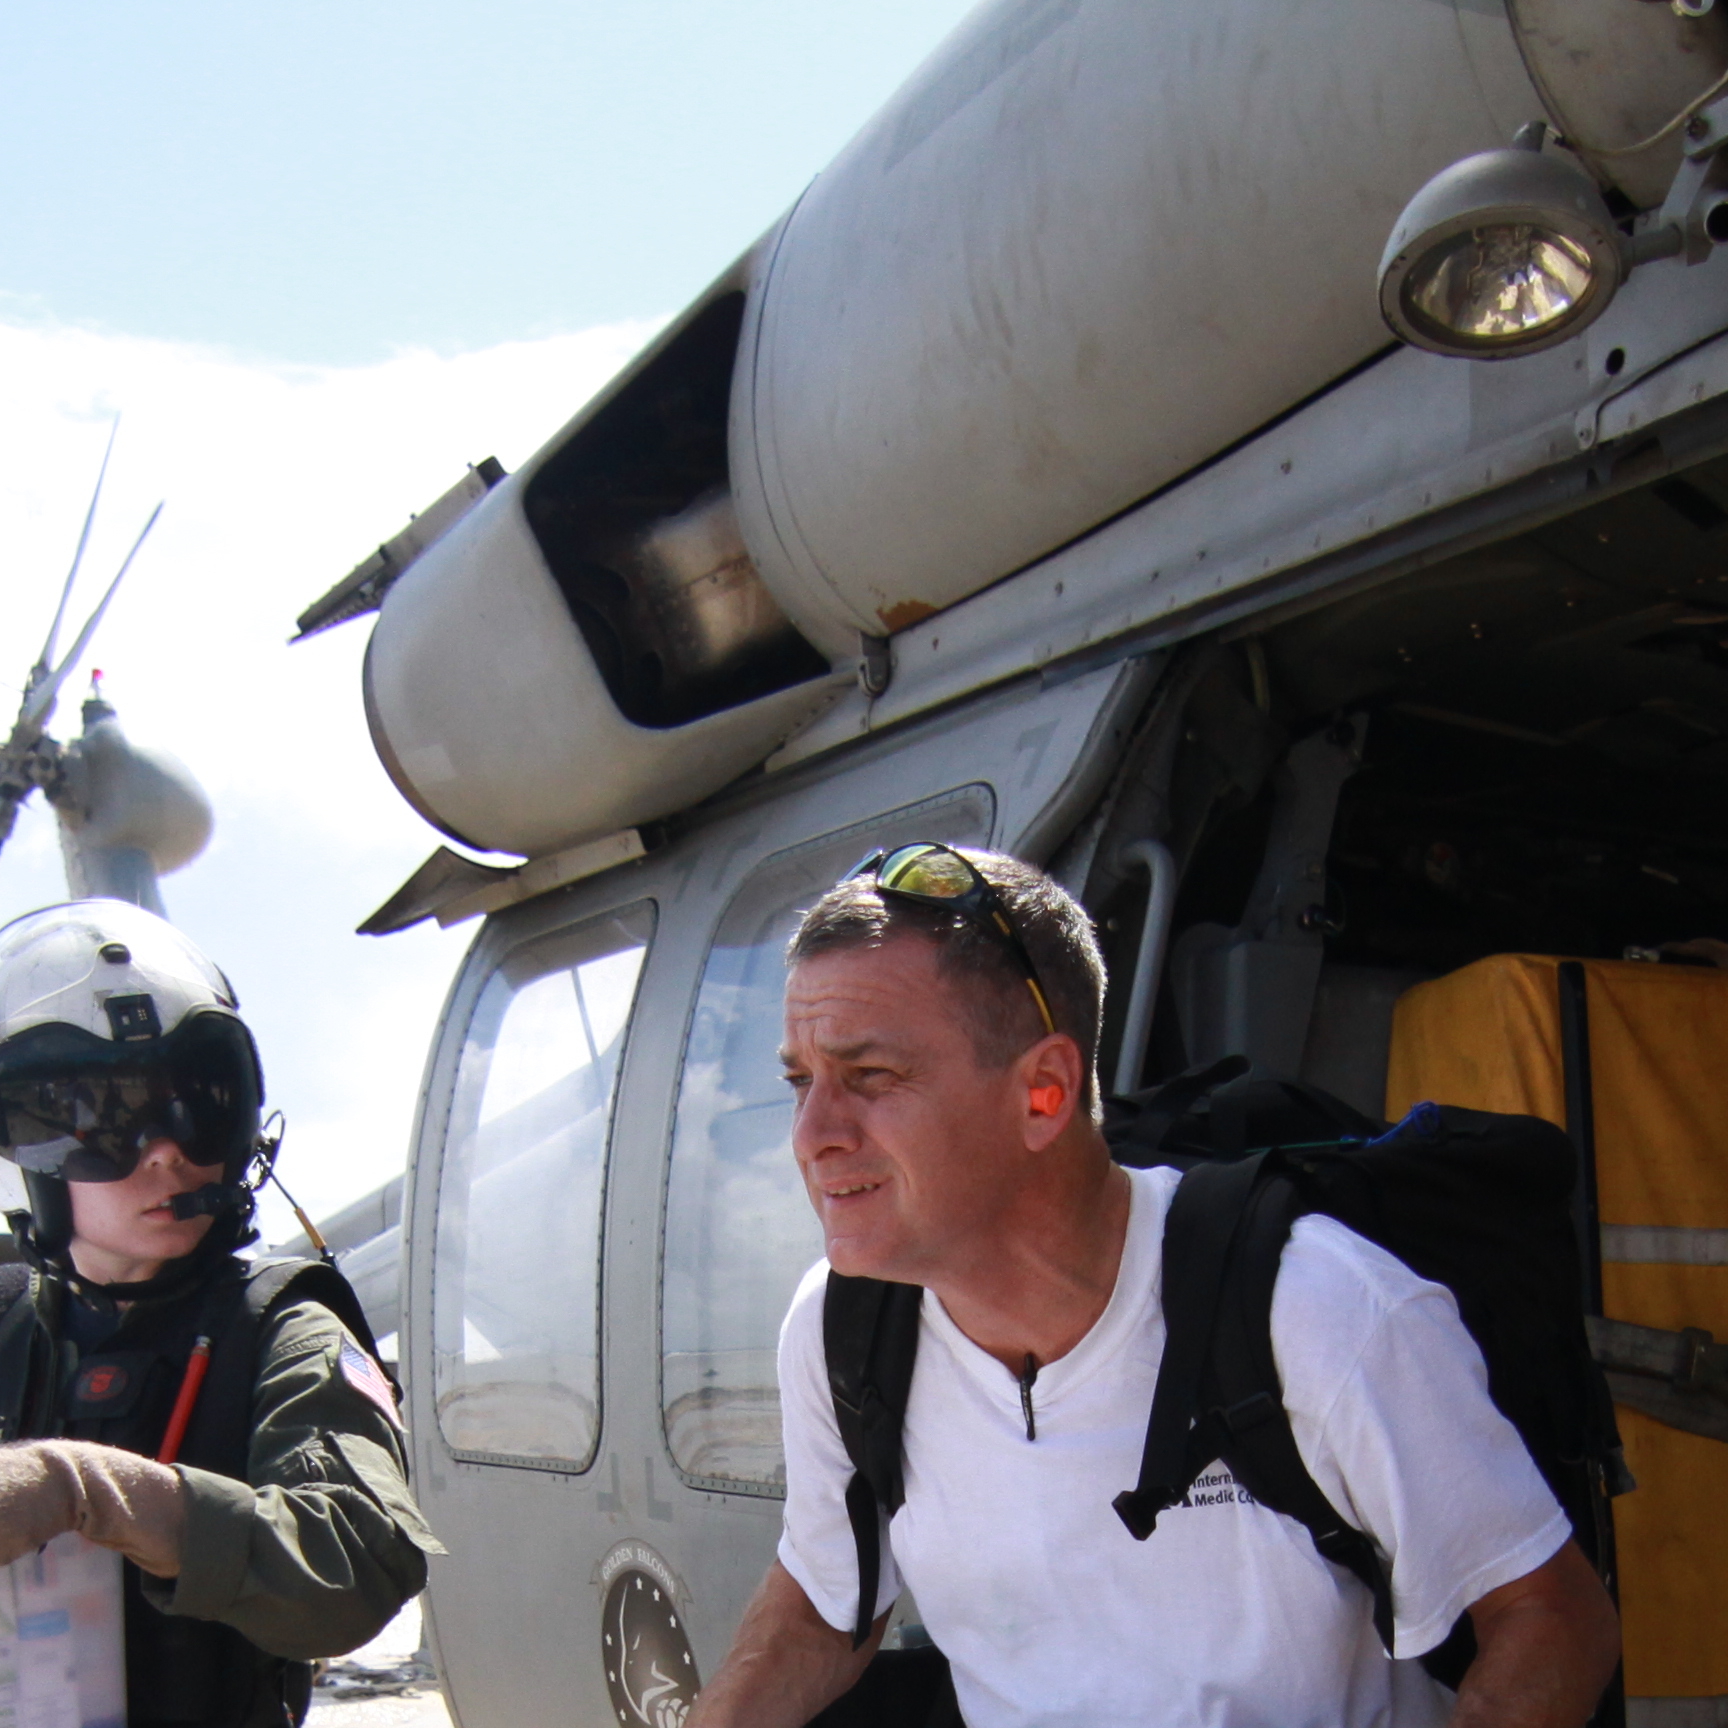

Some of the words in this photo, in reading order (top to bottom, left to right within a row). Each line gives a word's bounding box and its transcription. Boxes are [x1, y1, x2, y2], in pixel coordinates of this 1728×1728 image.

[1192, 1473, 1236, 1489] Intern
[602, 1547, 633, 1580] GOLDEN
[636, 1547, 674, 1593] FALCONS
